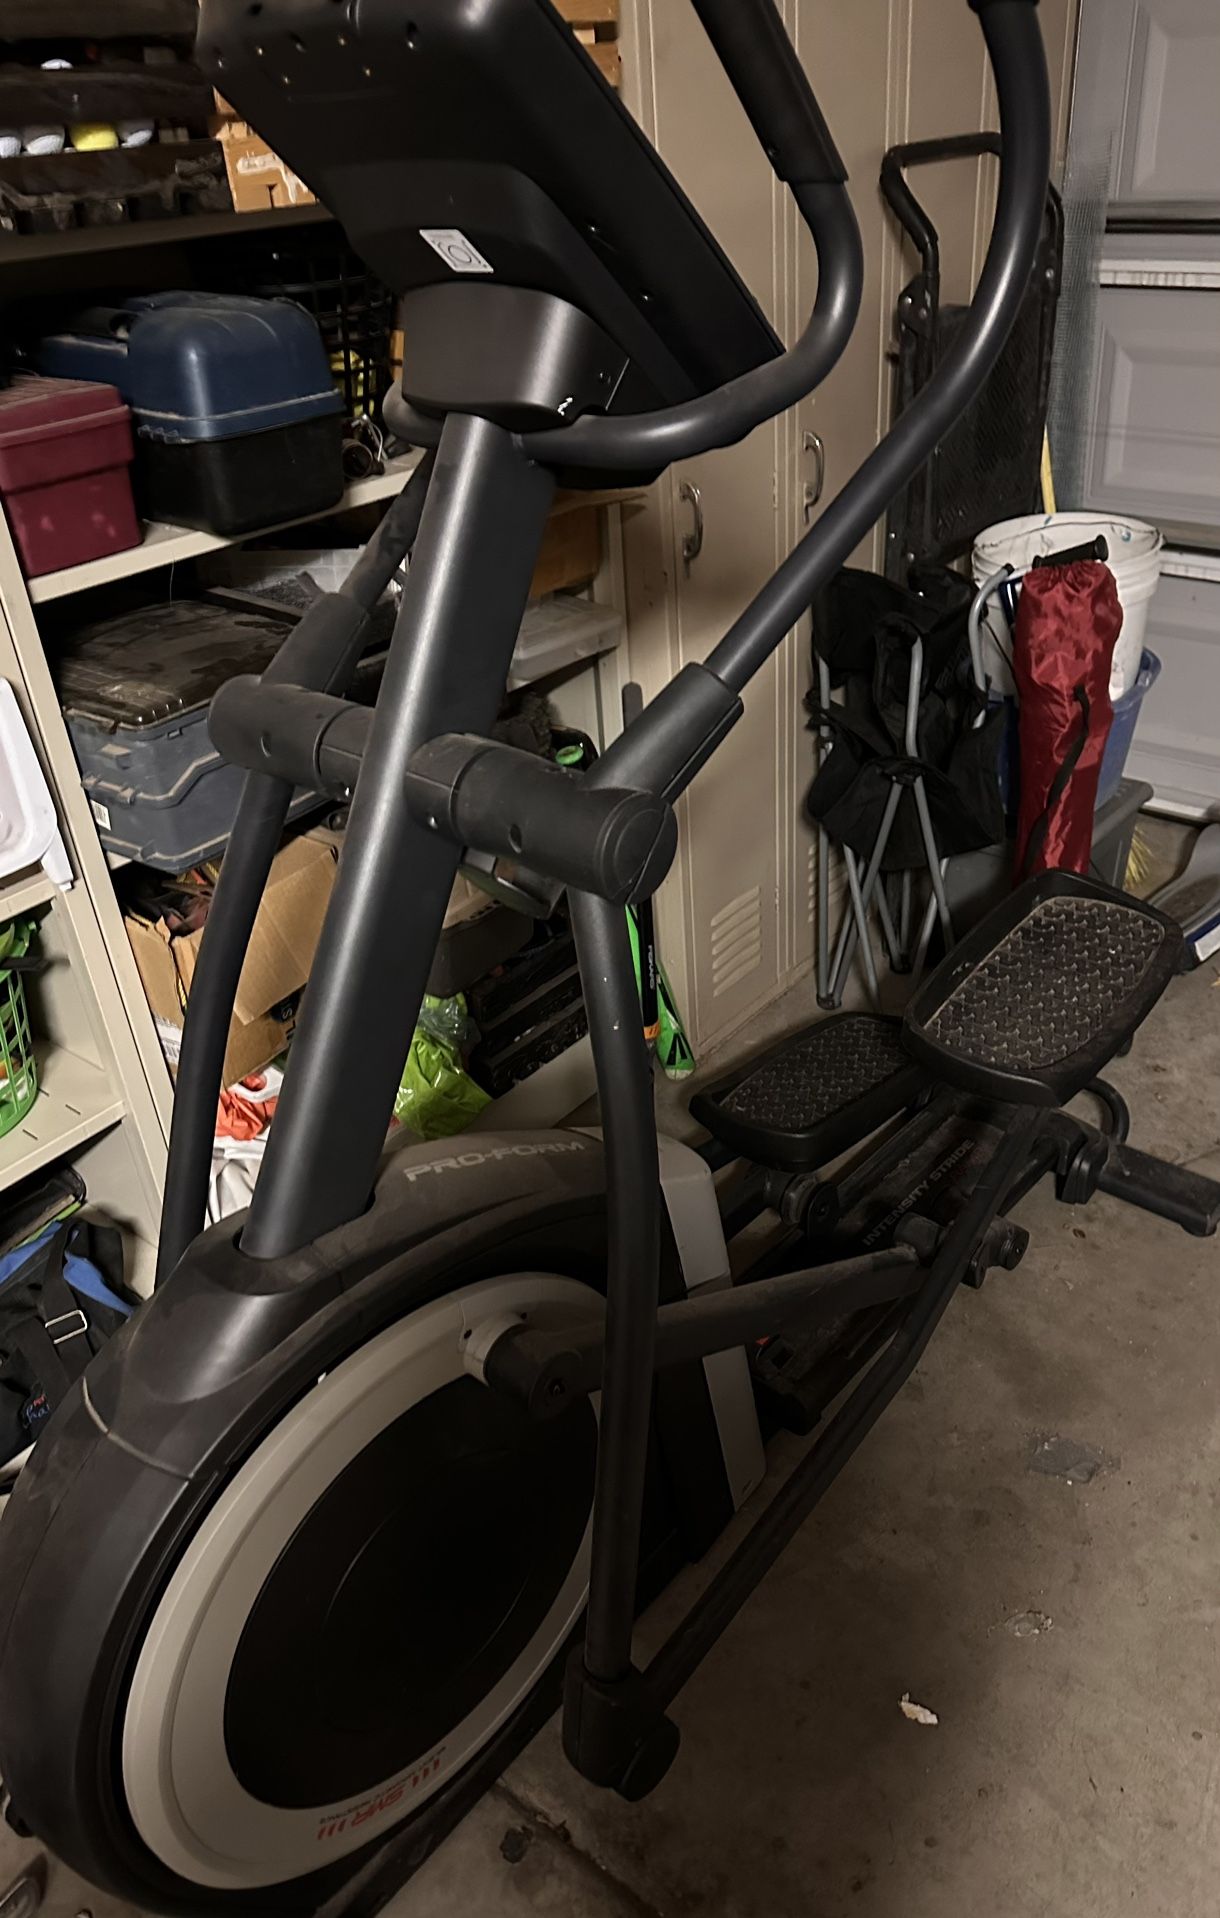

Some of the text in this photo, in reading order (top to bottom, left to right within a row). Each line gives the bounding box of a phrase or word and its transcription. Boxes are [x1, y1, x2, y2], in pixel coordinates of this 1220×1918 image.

[403, 1141, 585, 1182] PRO-FORM
[861, 1139, 976, 1246] INTENSITY STRIDE
